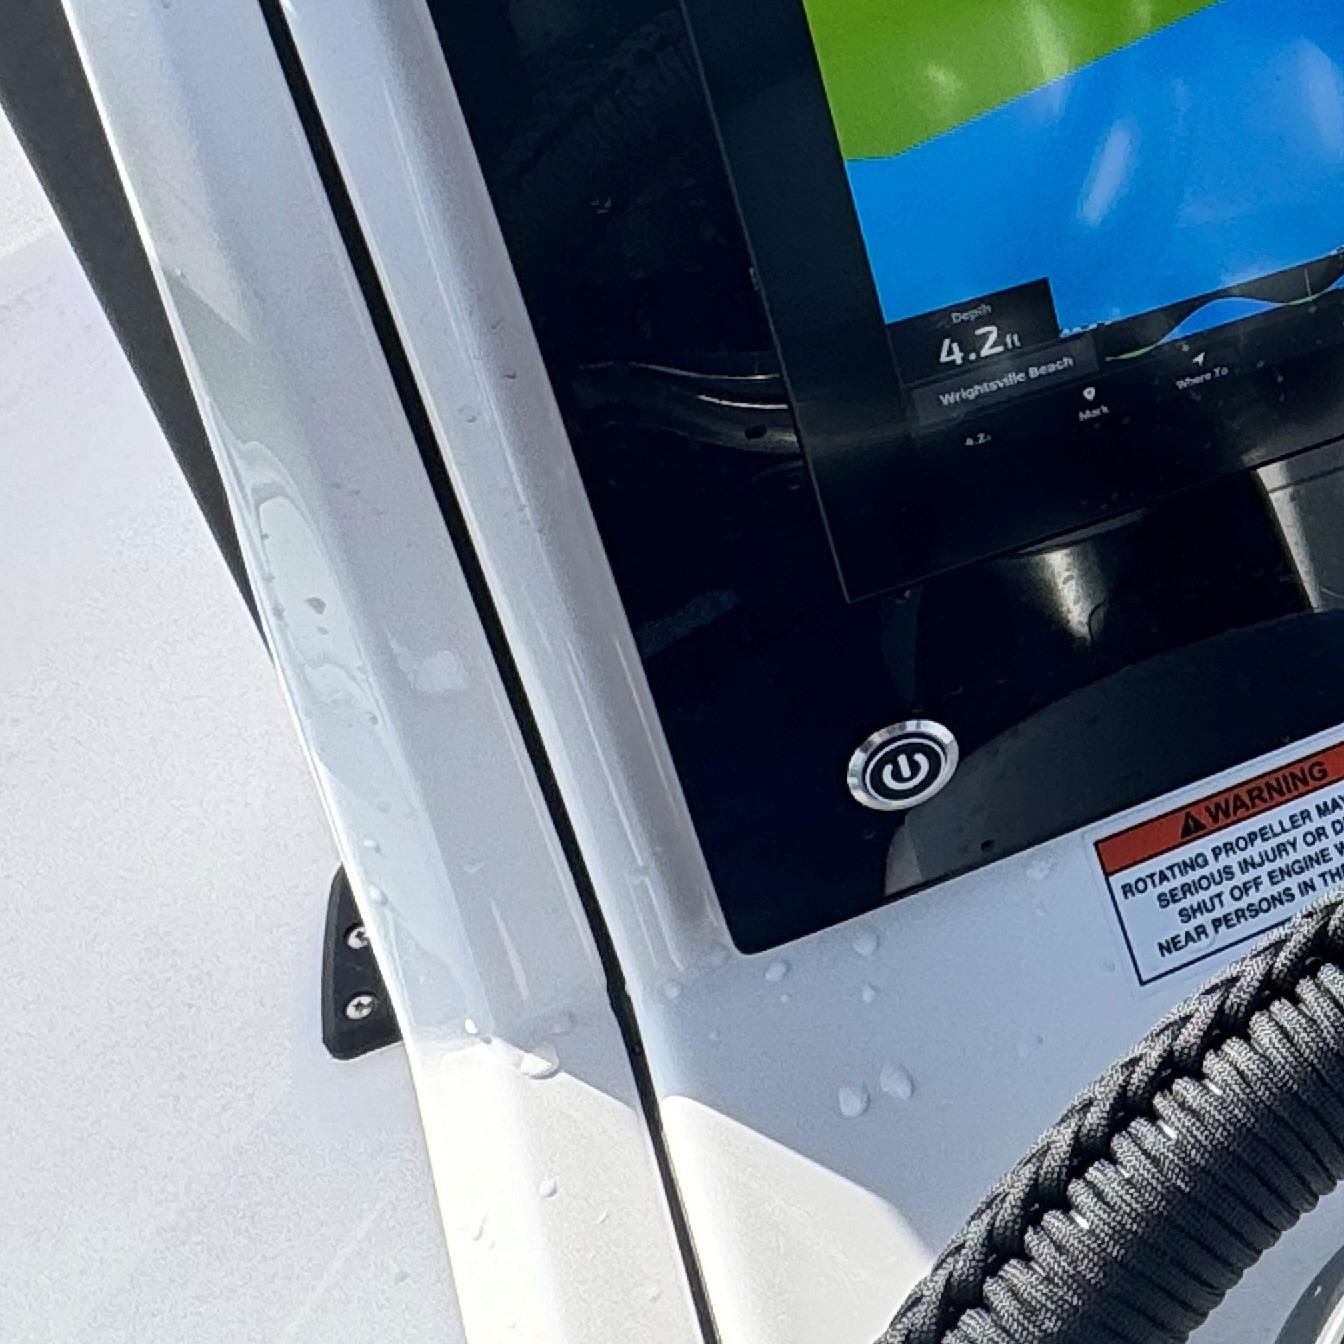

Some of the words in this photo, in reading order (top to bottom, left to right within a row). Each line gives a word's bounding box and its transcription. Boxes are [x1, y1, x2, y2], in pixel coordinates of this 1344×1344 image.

[938, 370, 1027, 406] Wrightsville
[1028, 356, 1075, 380] Beach
[1205, 759, 1329, 824] WARNING
[1120, 850, 1210, 900] ROTATING
[1212, 807, 1313, 862] PROPELLER
[1157, 864, 1237, 909] SERIOUS
[1238, 840, 1299, 874] INJURY
[1302, 825, 1328, 847] OR
[1177, 892, 1225, 925] SHUT
[1231, 876, 1265, 902] OFF
[1267, 852, 1331, 888] ENGINE
[1156, 924, 1210, 958] NEAR
[1212, 886, 1297, 935] PERSONS
[1299, 876, 1317, 899] IN
